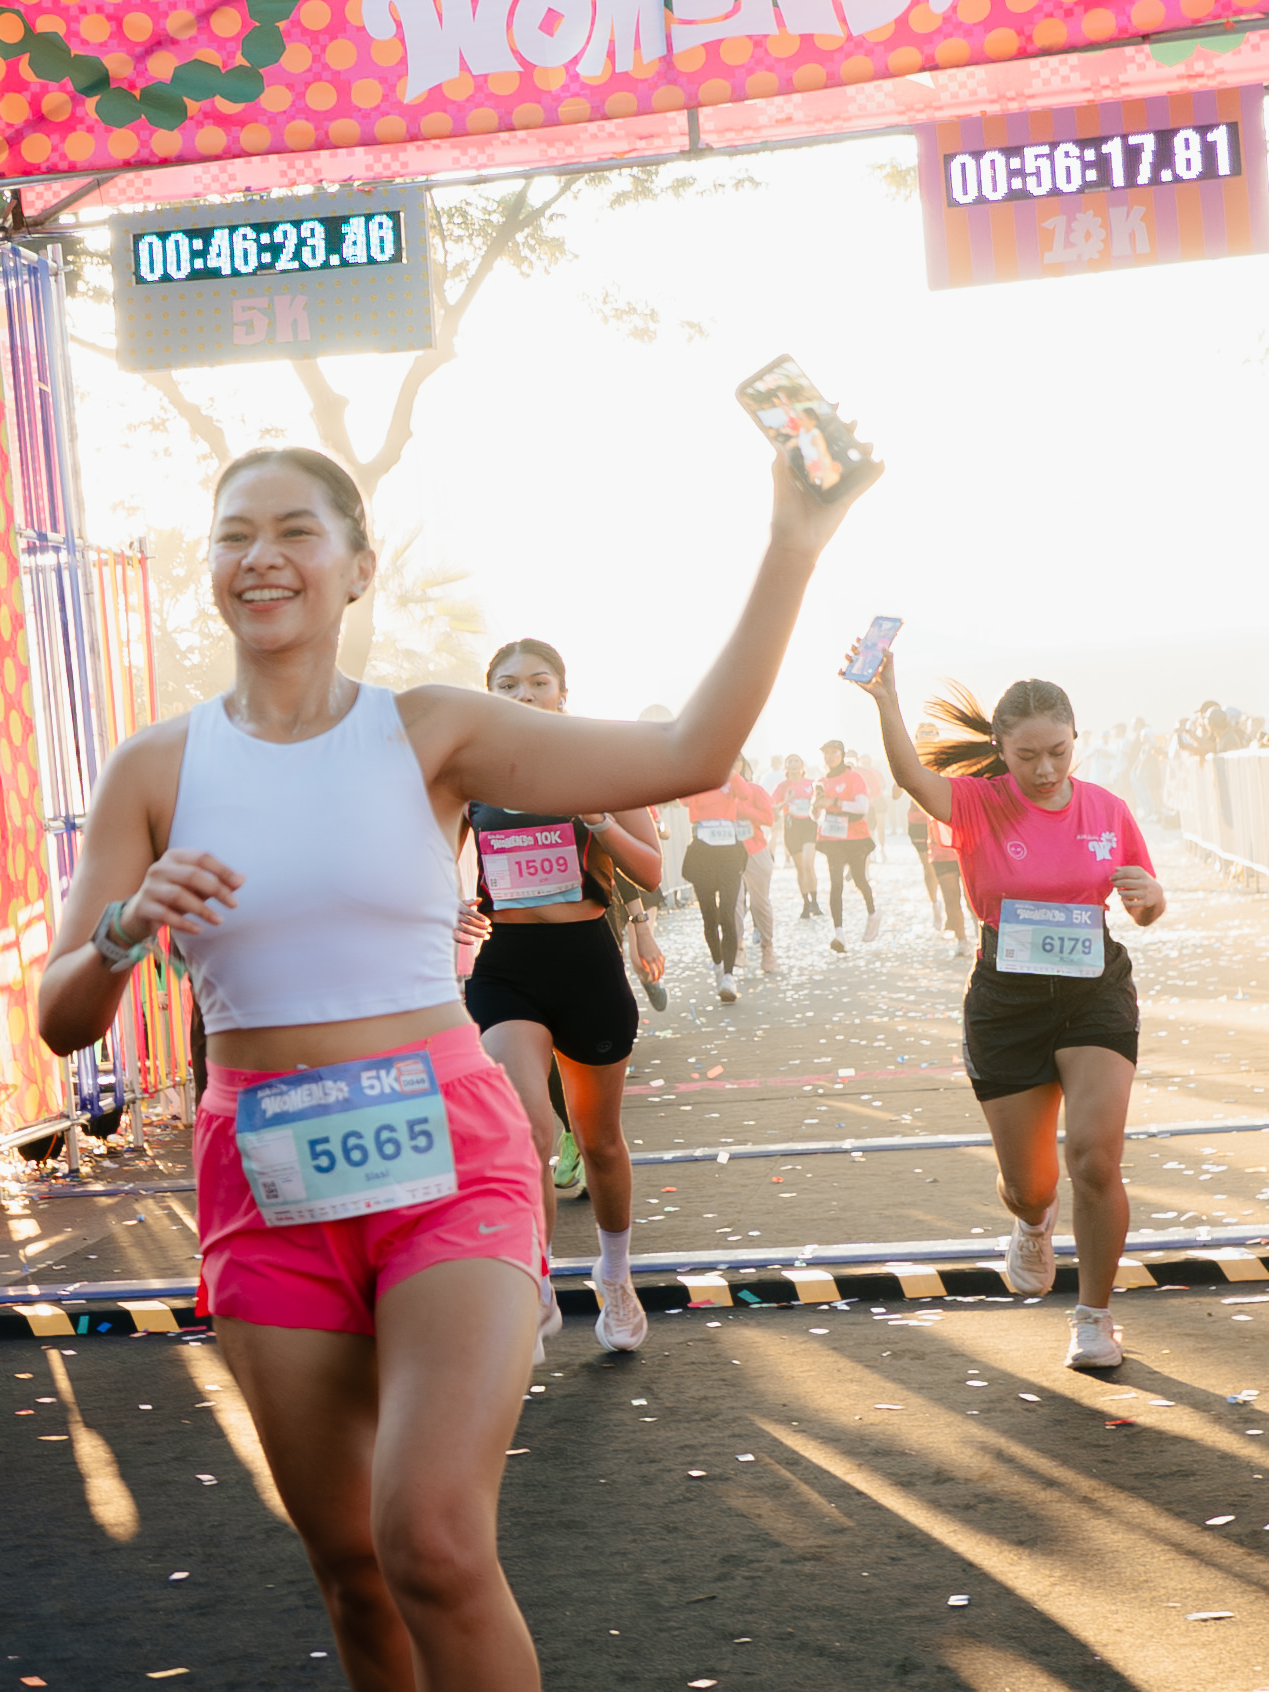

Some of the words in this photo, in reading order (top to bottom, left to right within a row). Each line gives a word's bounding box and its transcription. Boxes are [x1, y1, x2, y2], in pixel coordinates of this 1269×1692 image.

[950, 124, 1231, 205] 00:56:17.81
[232, 293, 311, 346] 5K
[535, 831, 562, 846] 10K
[515, 856, 569, 878] 1509
[1072, 910, 1092, 924] 5K
[1041, 935, 1093, 956] 6179
[360, 1068, 400, 1096] 5K
[307, 1116, 434, 1174] 5665
